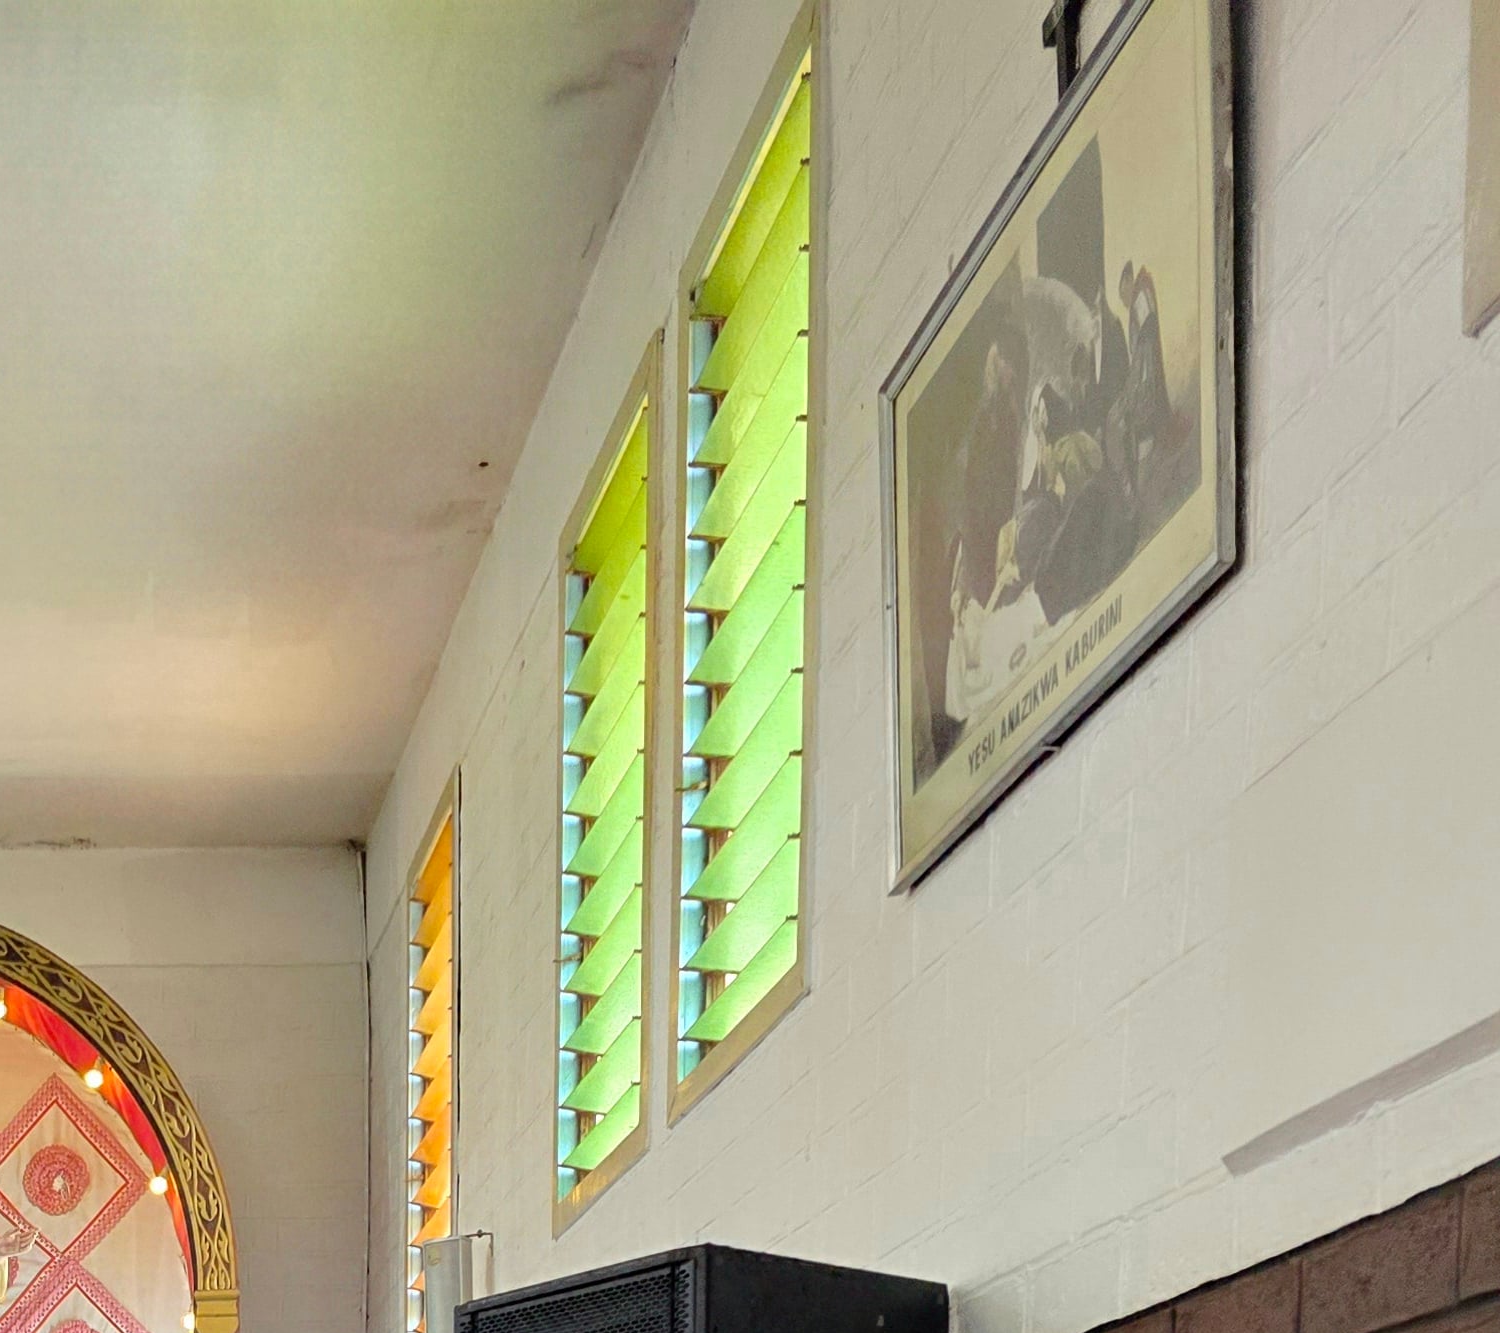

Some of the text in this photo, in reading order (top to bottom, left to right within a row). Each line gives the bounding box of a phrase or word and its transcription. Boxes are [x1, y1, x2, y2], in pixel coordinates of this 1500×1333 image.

[968, 593, 1123, 776] YESU ANAZIKWA KABURINI
